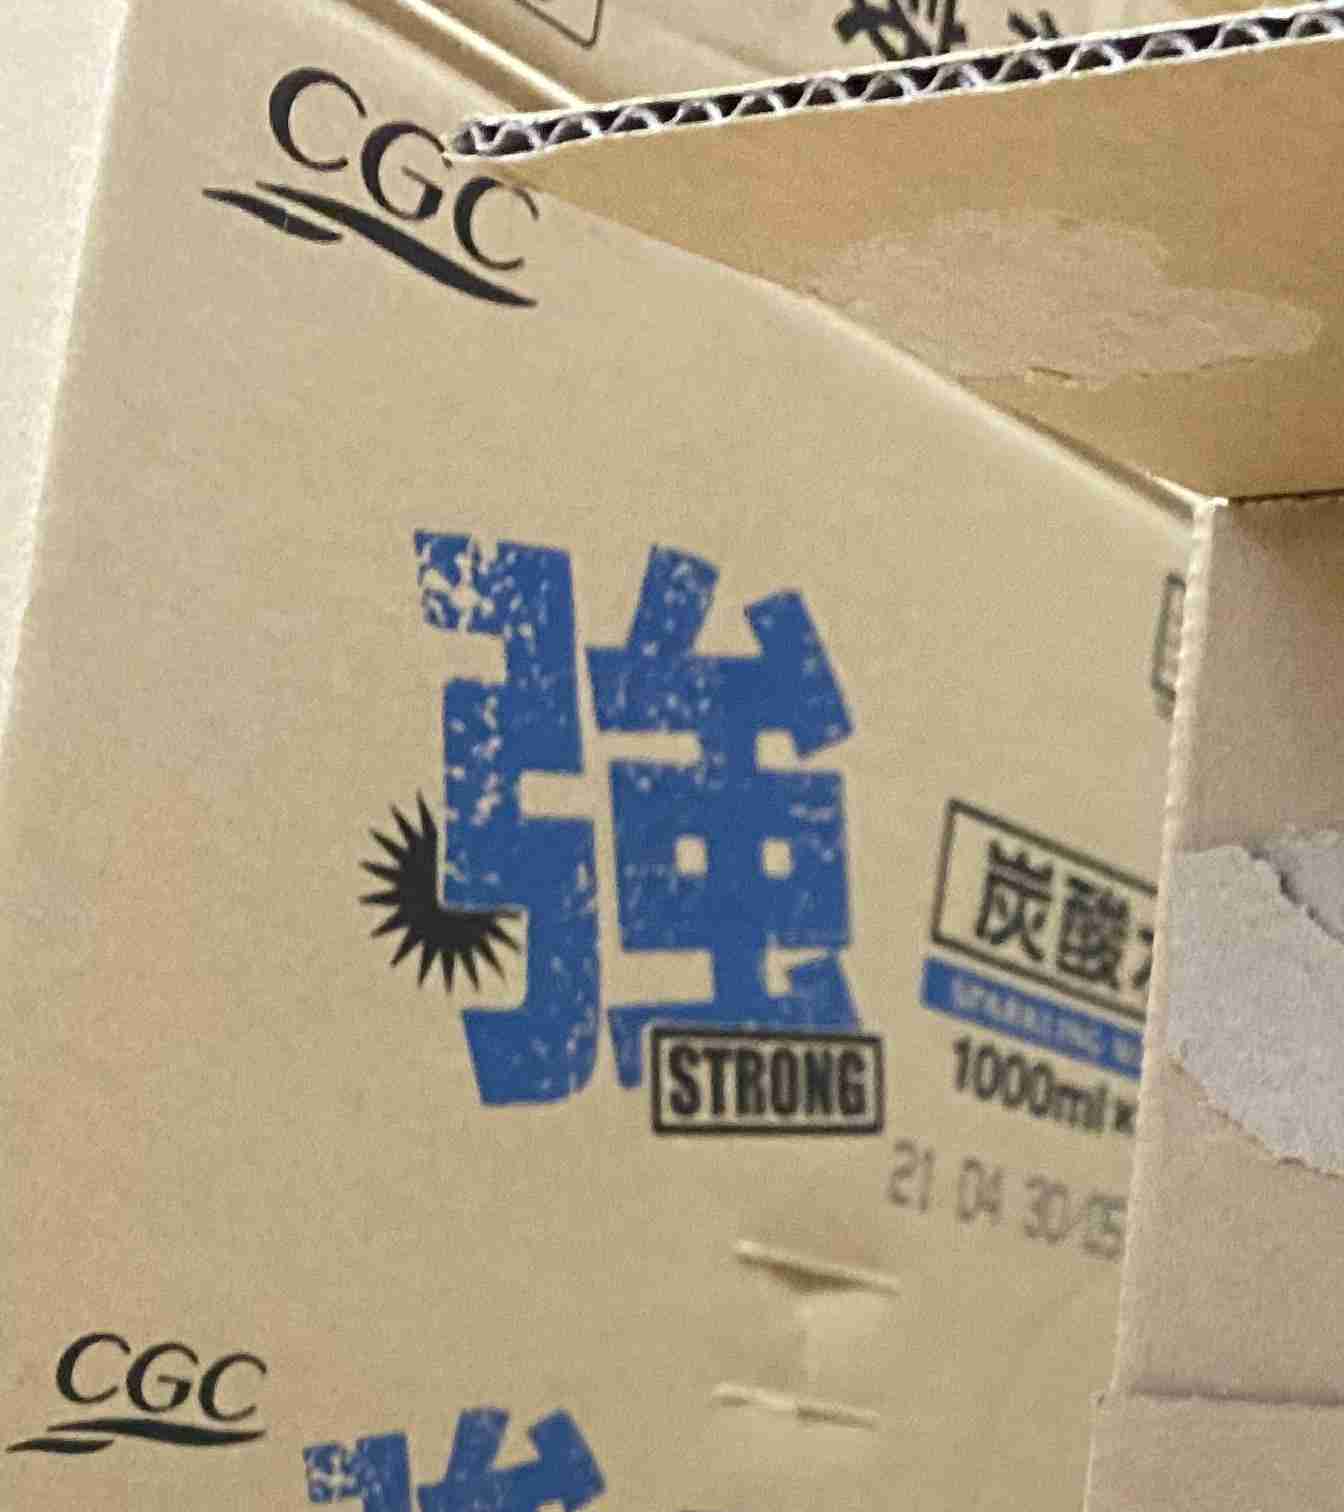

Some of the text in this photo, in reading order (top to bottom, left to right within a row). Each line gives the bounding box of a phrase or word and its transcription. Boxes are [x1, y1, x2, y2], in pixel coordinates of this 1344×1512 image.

[269, 66, 539, 270] CGC
[414, 529, 853, 1106] 強
[669, 1045, 866, 1115] STRONG
[56, 1332, 267, 1422] CGC
